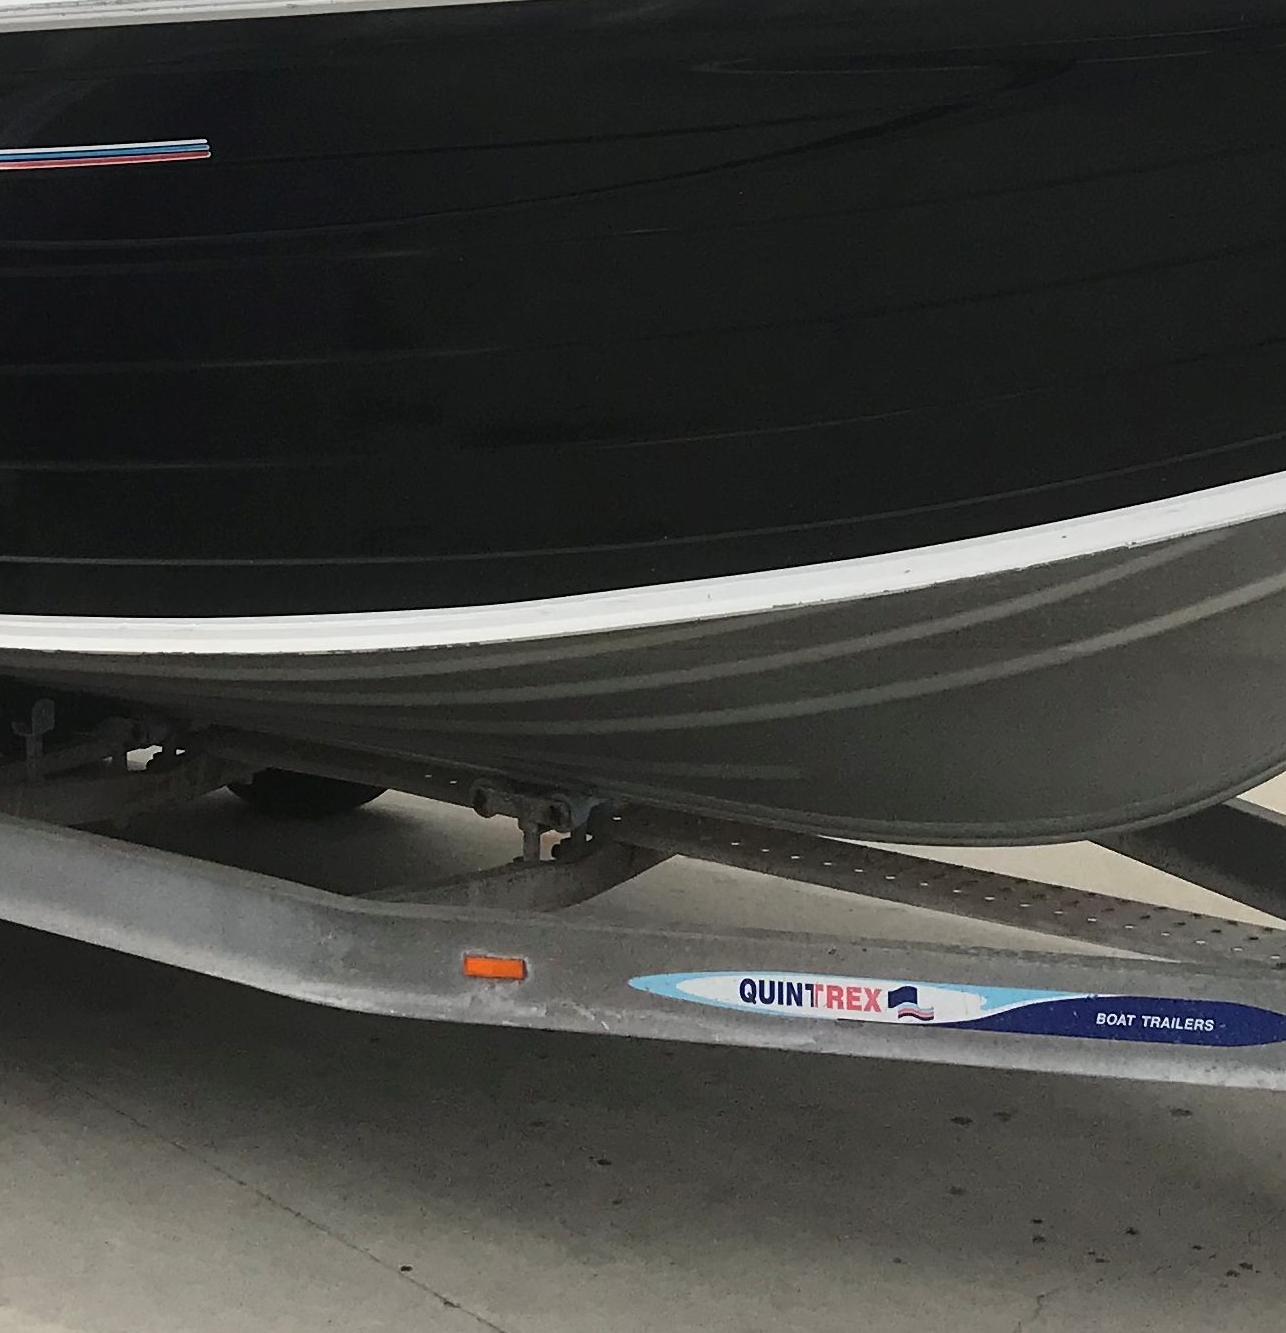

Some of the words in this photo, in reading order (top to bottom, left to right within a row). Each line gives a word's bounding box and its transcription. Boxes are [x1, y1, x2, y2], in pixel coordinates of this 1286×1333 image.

[739, 978, 883, 1013] QUINTREX
[1095, 1012, 1137, 1027] BOAT
[1141, 1015, 1215, 1032] TRAILERS
